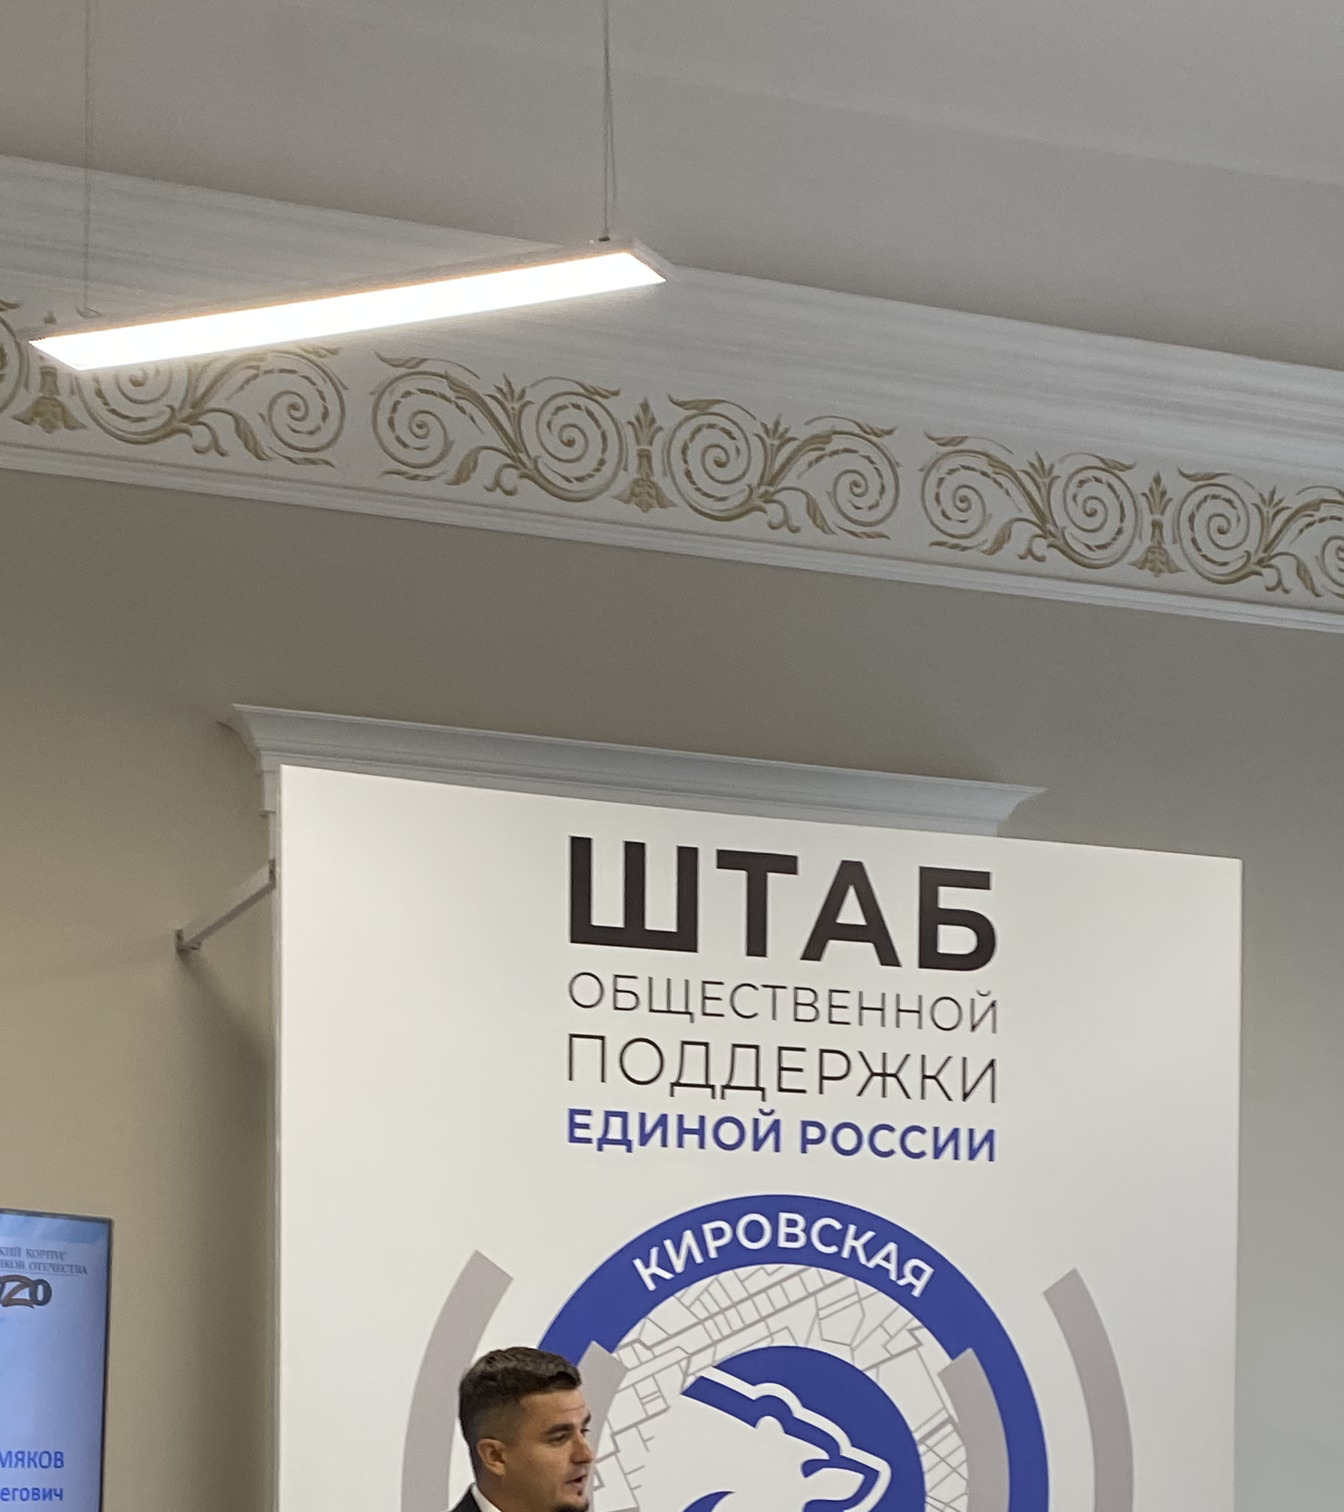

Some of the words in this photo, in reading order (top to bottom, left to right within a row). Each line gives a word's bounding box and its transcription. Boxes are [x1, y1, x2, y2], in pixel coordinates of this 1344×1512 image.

[569, 835, 997, 972] ШТАБ
[569, 972, 998, 1034] ОБЩЕСТВЕННОЙ
[568, 1033, 997, 1104] ПОДДЕРЖКИ
[568, 1107, 782, 1153] ЕДИНОЙ
[800, 1119, 997, 1162] РОССИИ
[26, 1248, 67, 1261] КОРПУС
[29, 1261, 88, 1275] ОТЕЧЕСТВА
[632, 1211, 934, 1297] КИРОВСКАЯ
